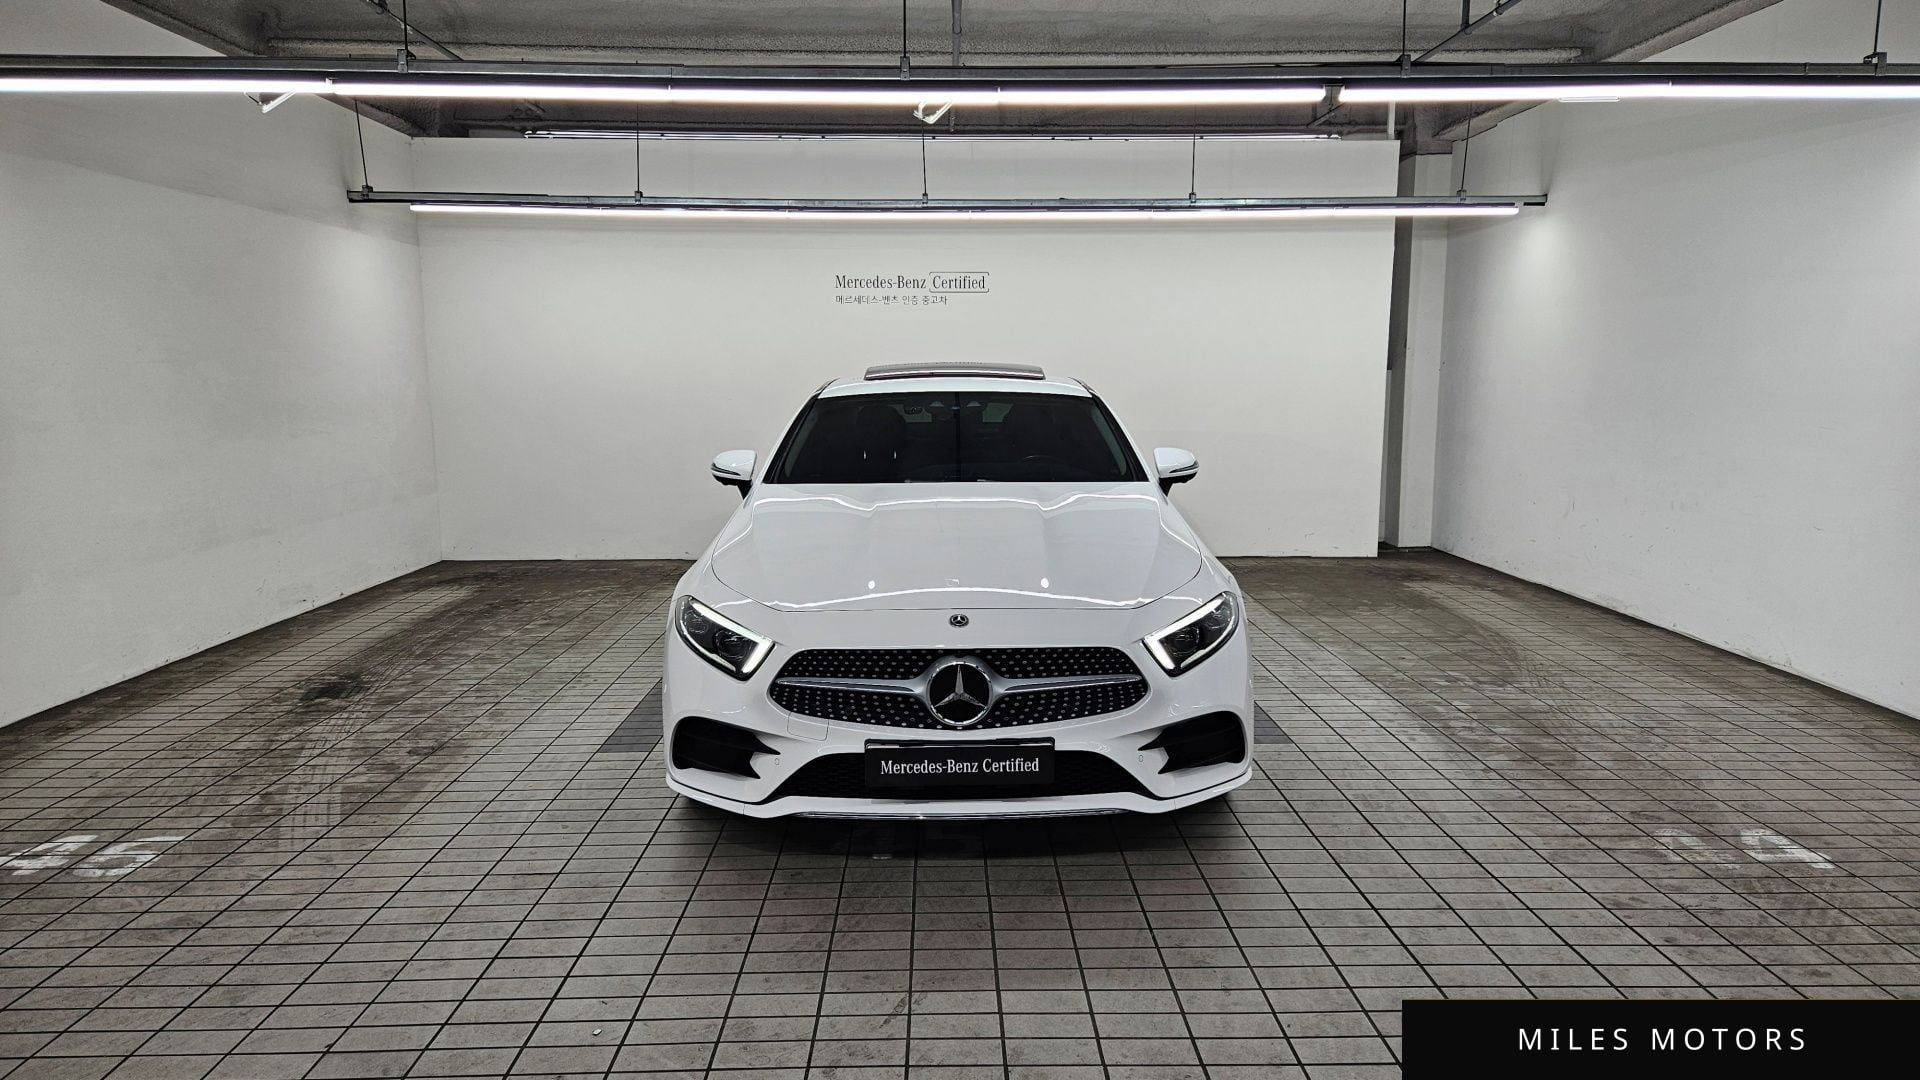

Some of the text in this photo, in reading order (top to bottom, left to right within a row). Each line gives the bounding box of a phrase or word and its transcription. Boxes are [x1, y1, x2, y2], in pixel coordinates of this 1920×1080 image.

[835, 274, 986, 289] Mercedes-Benz Certified
[835, 295, 948, 306] 메르세데스-벤츠 인증 중고차
[880, 757, 1040, 775] Mercedes-Benz Certified
